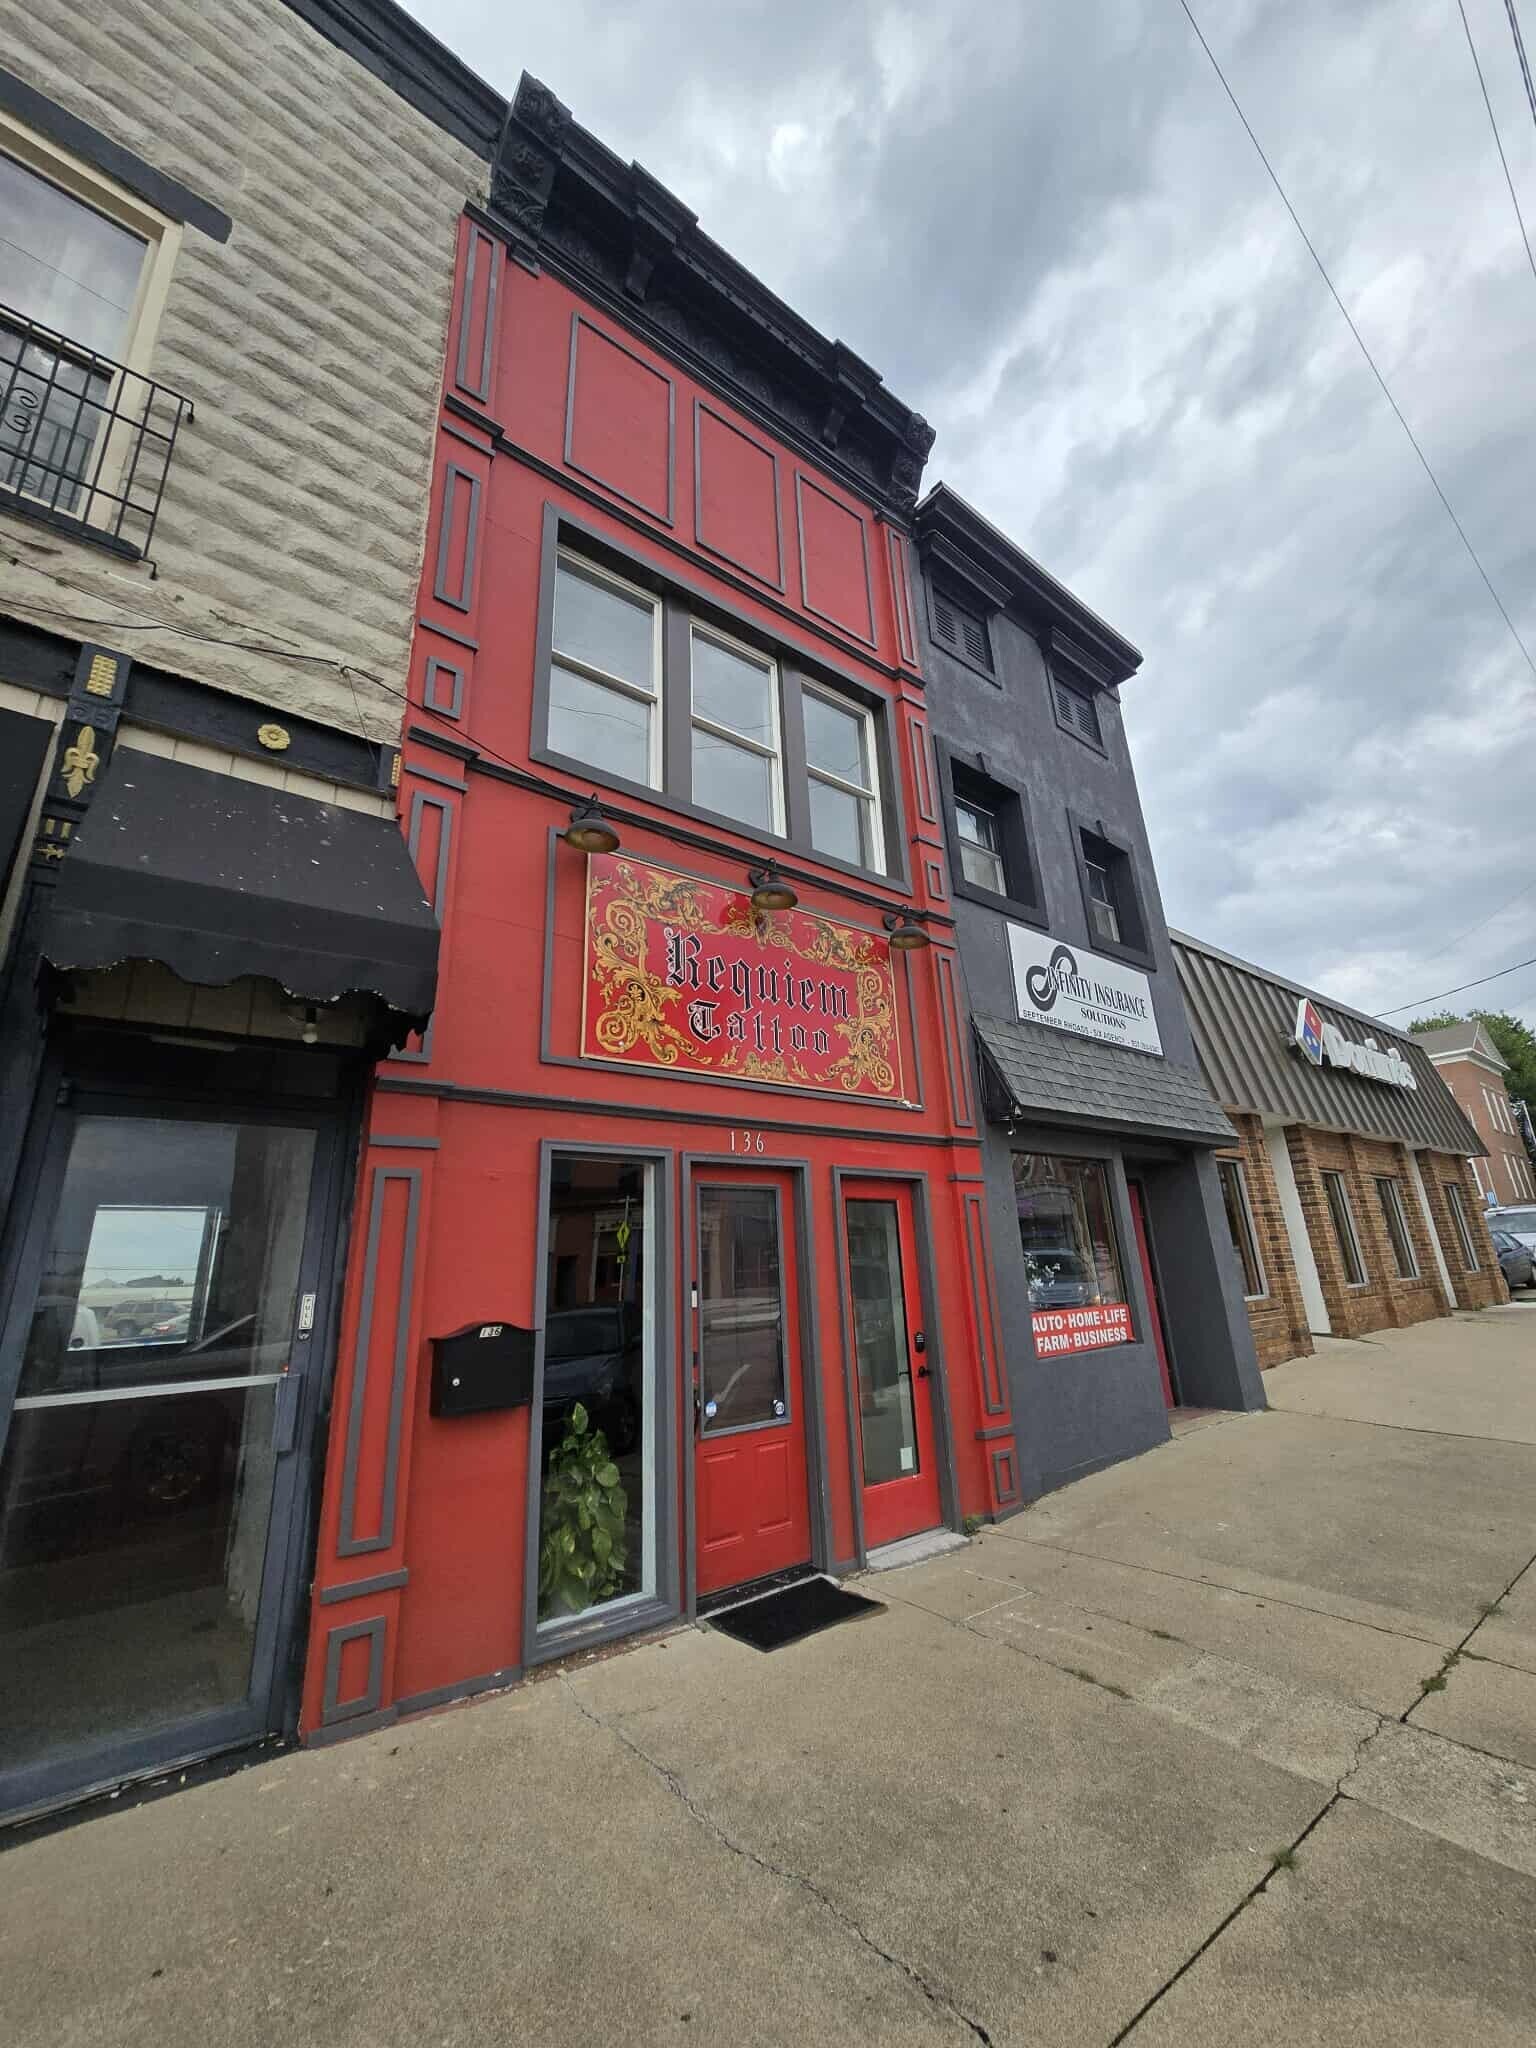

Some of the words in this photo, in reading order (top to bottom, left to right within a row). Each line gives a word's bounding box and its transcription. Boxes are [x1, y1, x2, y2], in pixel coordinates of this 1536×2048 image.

[664, 927, 851, 1020] Requiem
[1047, 966, 1092, 1001] INFINITY
[1094, 982, 1148, 1019] INSURANCE
[688, 1000, 830, 1056] Tattoo
[1080, 1007, 1127, 1030] SOLUTIONS
[731, 1130, 764, 1153] 136
[1103, 1308, 1127, 1324] LIFE
[482, 1326, 503, 1337] 136
[1036, 1333, 1070, 1353] FARM
[1073, 1327, 1128, 1348] BUSINESS
